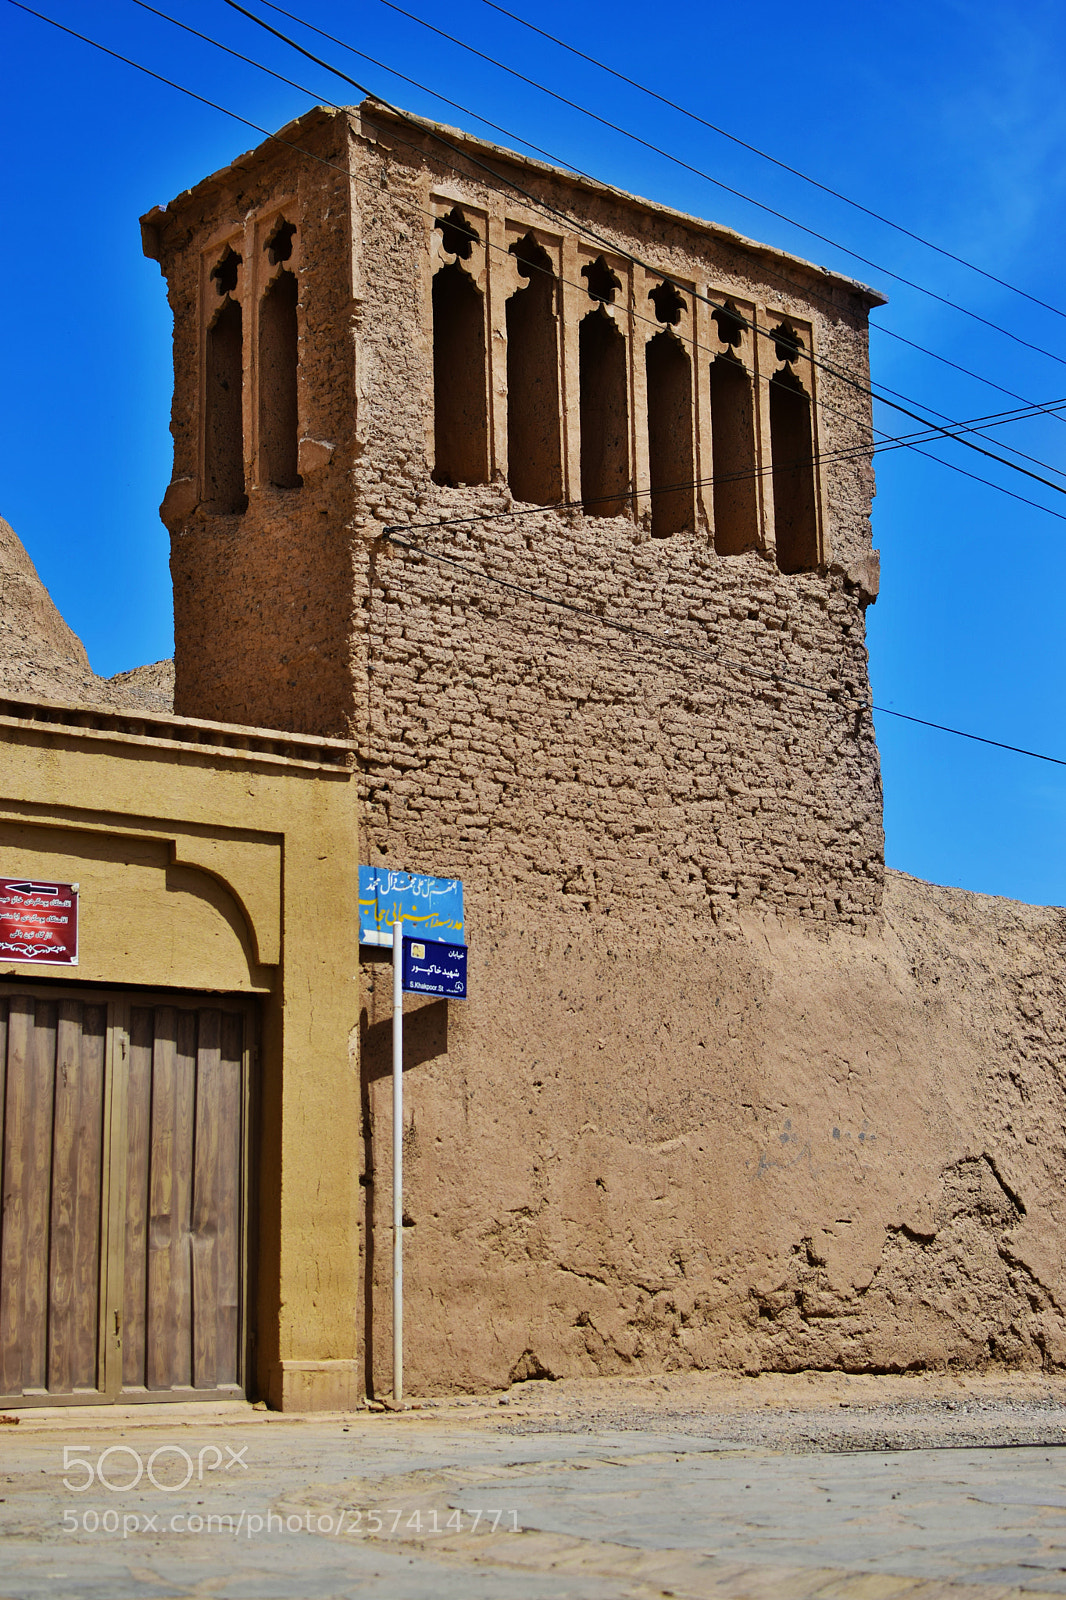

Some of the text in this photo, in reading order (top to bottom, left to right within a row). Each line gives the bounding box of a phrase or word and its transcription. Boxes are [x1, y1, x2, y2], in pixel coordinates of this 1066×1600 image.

[448, 950, 465, 960] خیابان
[411, 964, 460, 979] شهید خاکپور
